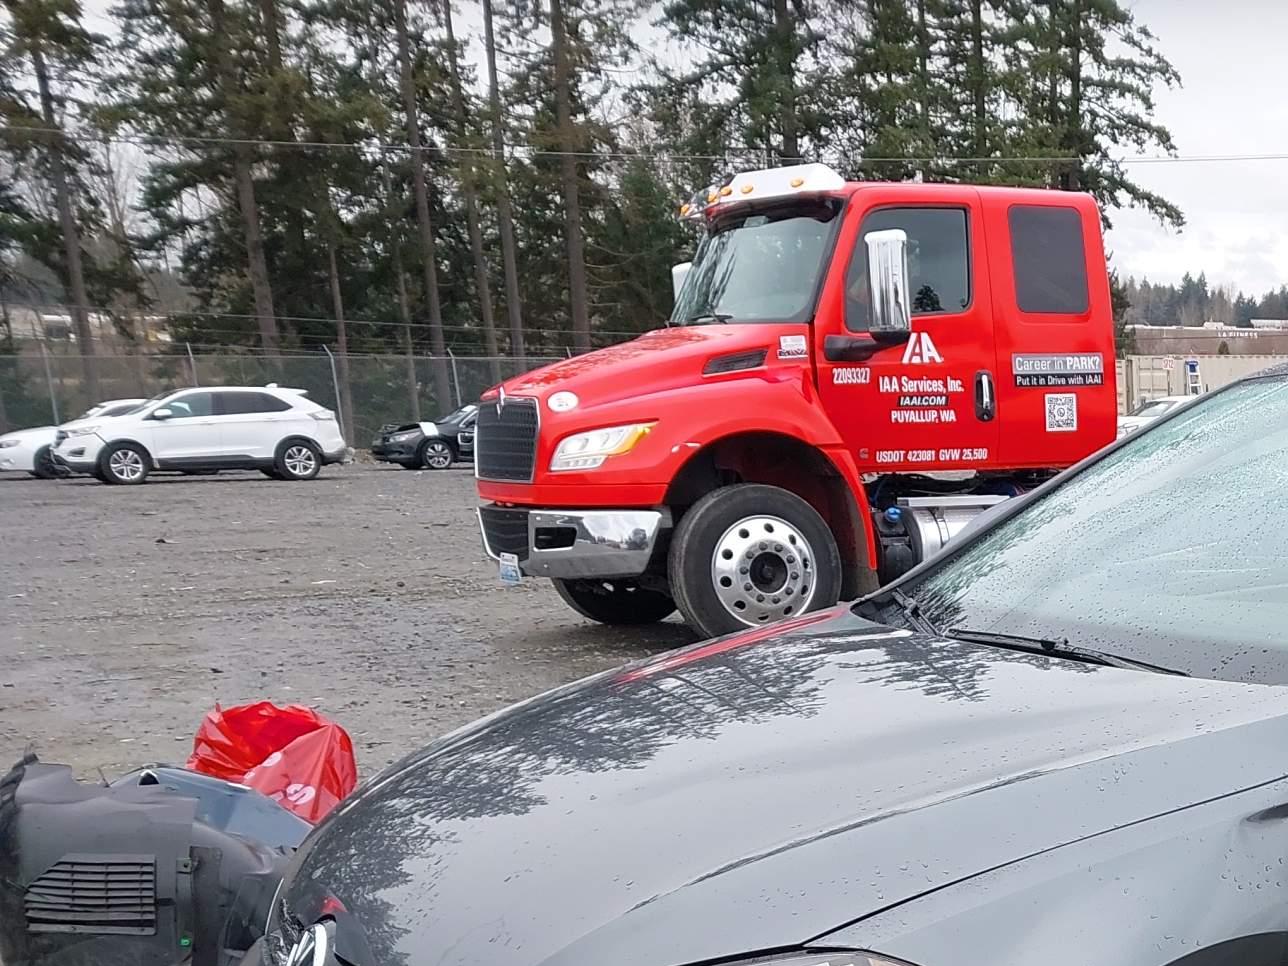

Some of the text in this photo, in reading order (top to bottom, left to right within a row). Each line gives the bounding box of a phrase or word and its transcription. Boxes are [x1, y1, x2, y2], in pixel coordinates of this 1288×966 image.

[1015, 356, 1100, 371] Career in PARK?
[832, 367, 871, 385] 22093327
[1016, 374, 1102, 386] Put it in Drive with IAAI
[879, 375, 965, 394] IAA Services, Inc.
[891, 409, 957, 423] PUYALLUP, WA
[876, 450, 905, 462] USDOT
[907, 450, 935, 462] 423081
[939, 449, 960, 460] GVW
[962, 447, 988, 460] 25,500
